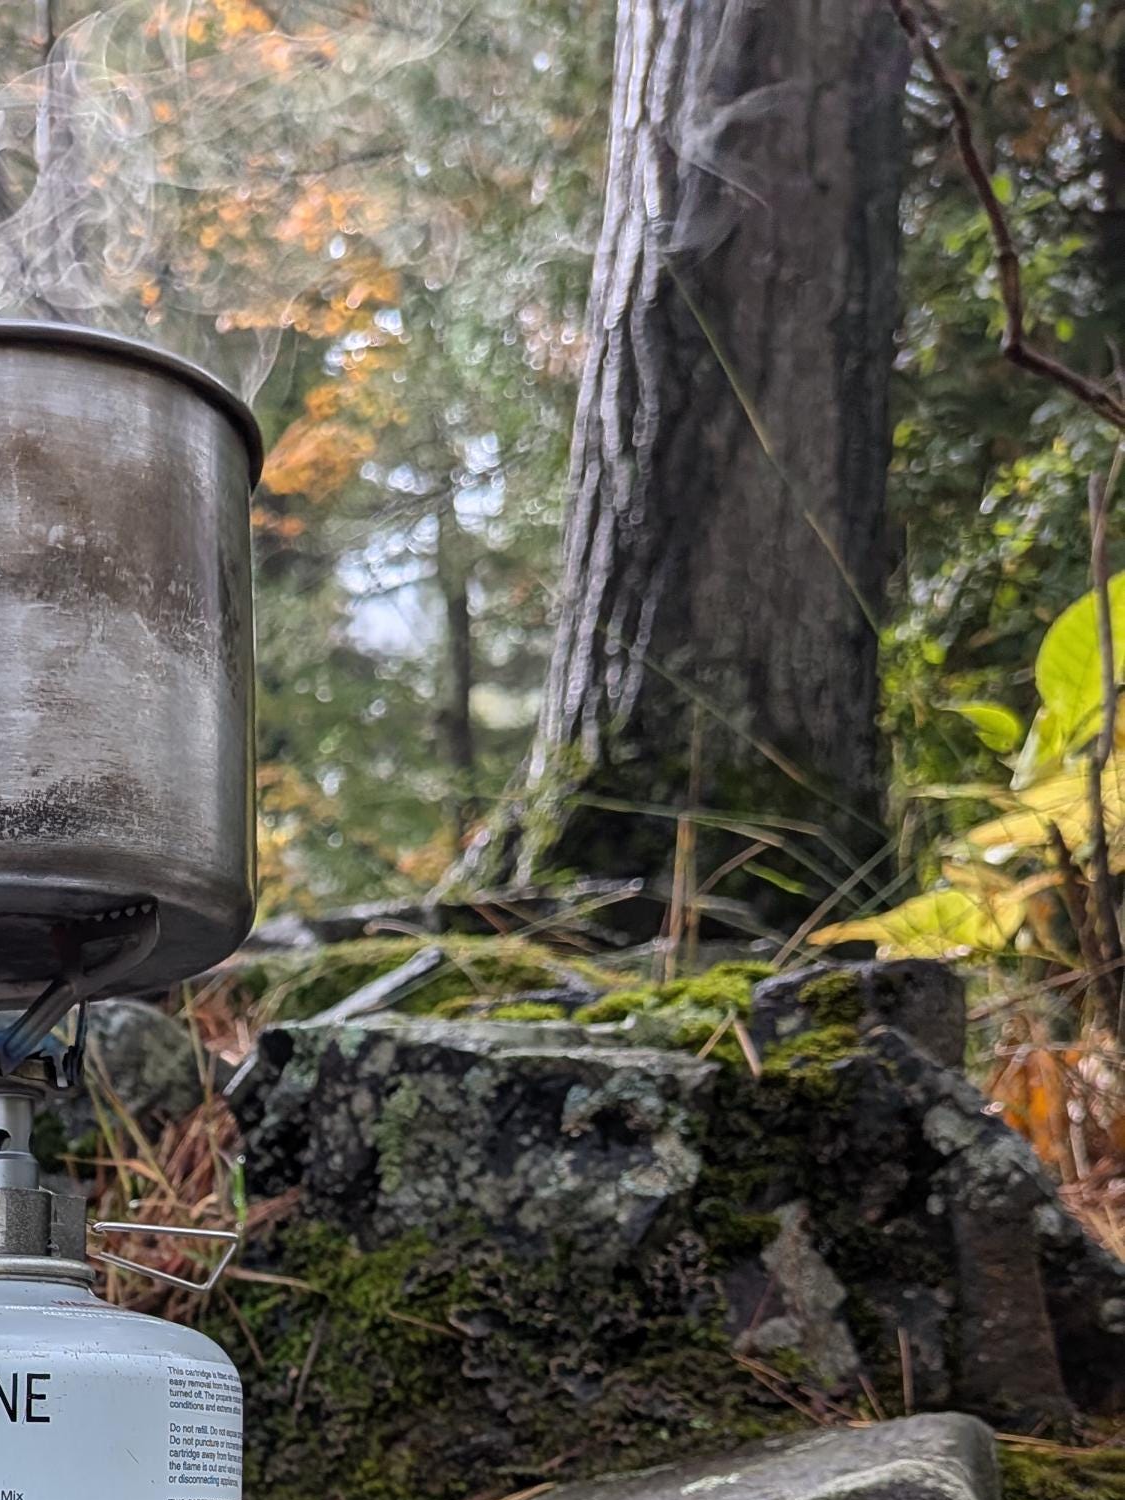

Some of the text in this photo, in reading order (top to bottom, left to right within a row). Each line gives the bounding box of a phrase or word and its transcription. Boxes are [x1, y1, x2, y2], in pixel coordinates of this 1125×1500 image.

[167, 1366, 183, 1376] This
[185, 1369, 211, 1380] cartridge
[169, 1378, 186, 1388] easy
[188, 1380, 211, 1389] removal
[169, 1388, 192, 1398] turned
[205, 1391, 215, 1400] The
[169, 1401, 204, 1410] conditions
[170, 1423, 181, 1432] Do
[183, 1425, 194, 1434] not
[170, 1435, 180, 1444] Do
[183, 1437, 194, 1445] not
[195, 1439, 219, 1448] puncture
[169, 1449, 200, 1460] cartridge
[169, 1460, 181, 1470] the
[169, 1475, 177, 1484] or
[178, 1474, 219, 1487] disconnecting
